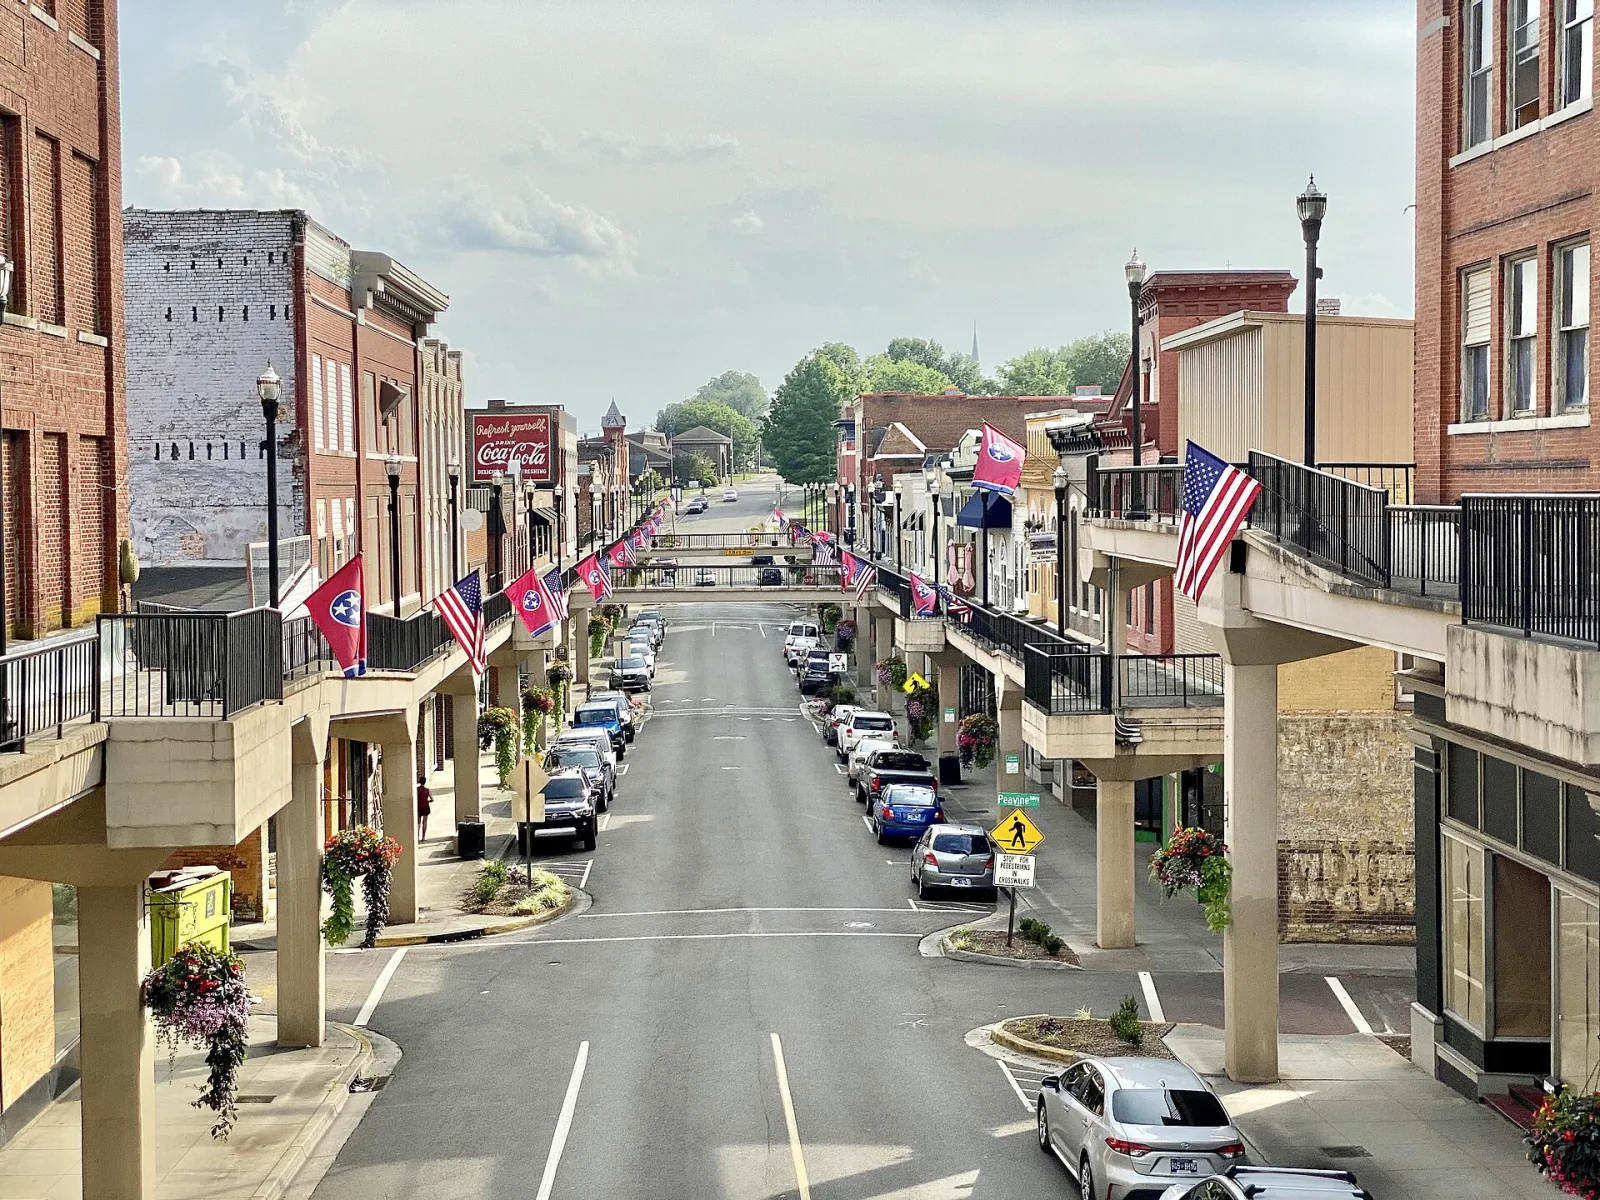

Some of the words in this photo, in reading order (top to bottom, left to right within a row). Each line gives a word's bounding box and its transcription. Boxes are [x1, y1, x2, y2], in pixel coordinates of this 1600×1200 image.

[476, 421, 510, 438] Refresh
[477, 442, 549, 466] Coca-Cola
[998, 794, 1029, 805] Peavine
[1000, 862, 1030, 871] PEDESTRIANS
[999, 876, 1030, 886] CROSSWALKS
